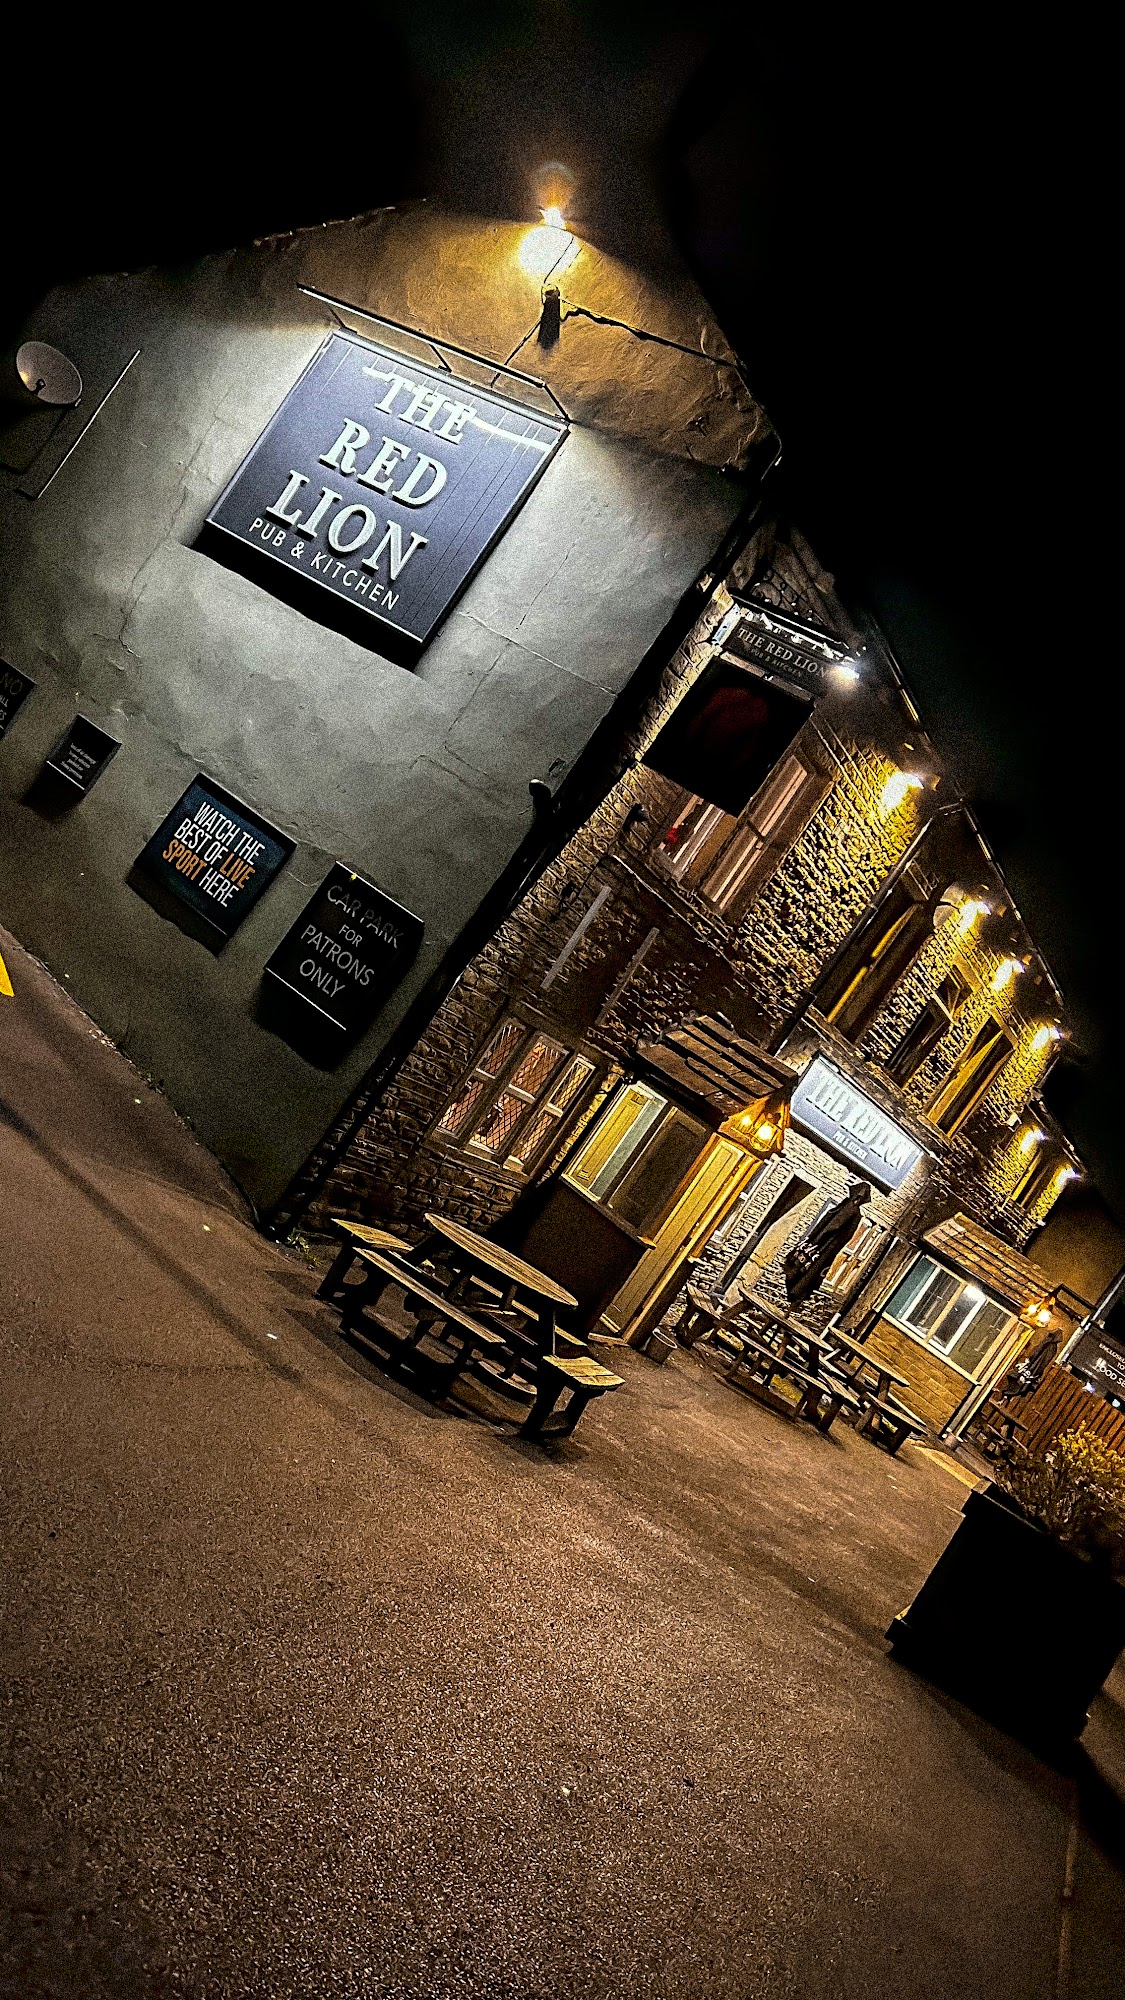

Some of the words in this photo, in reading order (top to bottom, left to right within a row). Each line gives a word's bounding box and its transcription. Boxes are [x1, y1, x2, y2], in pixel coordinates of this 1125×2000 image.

[374, 375, 477, 444] THE
[319, 418, 448, 508] RED
[265, 469, 428, 582] LION
[249, 518, 285, 548] PUB
[290, 540, 304, 559] &
[310, 551, 400, 611] KITCHEN
[738, 627, 763, 649] THE
[765, 641, 794, 661] RED
[793, 656, 828, 678] LION
[174, 818, 213, 854] BEST
[204, 841, 229, 866] OF
[218, 852, 256, 889] LIVE
[193, 801, 241, 847] WATCH
[233, 831, 266, 866] THE
[161, 838, 207, 881] SPORT
[198, 868, 240, 908] HERE
[327, 885, 363, 918] CAR
[359, 906, 407, 949] PARK
[338, 924, 363, 947] FOR
[299, 959, 347, 998] ONLY
[300, 925, 375, 986] PATRONS
